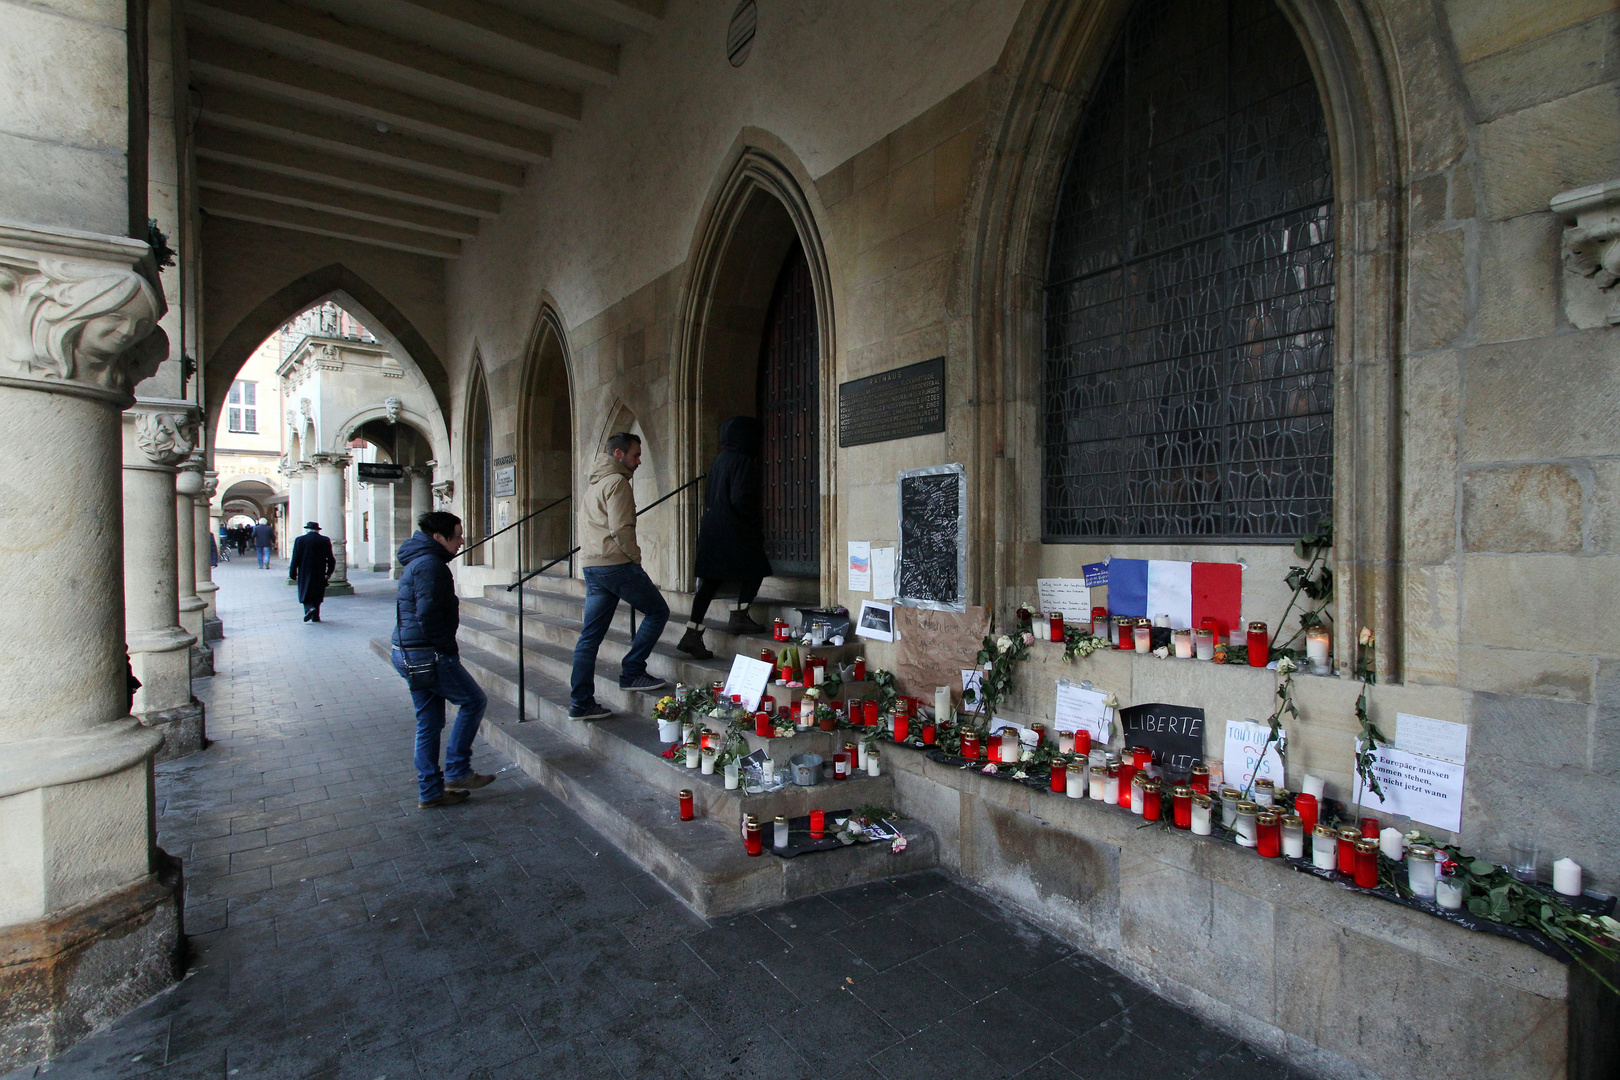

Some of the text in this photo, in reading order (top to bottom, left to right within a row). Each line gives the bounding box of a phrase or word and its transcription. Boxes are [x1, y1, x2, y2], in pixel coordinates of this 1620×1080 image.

[868, 372, 902, 385] RATHAUS
[1129, 713, 1203, 738] LIBERTE
[1247, 756, 1271, 775] PAS
[1380, 756, 1450, 780] Europäer müssen
[1383, 777, 1403, 788] nicht
[1404, 781, 1422, 794] jetzt
[1424, 788, 1448, 799] wann
